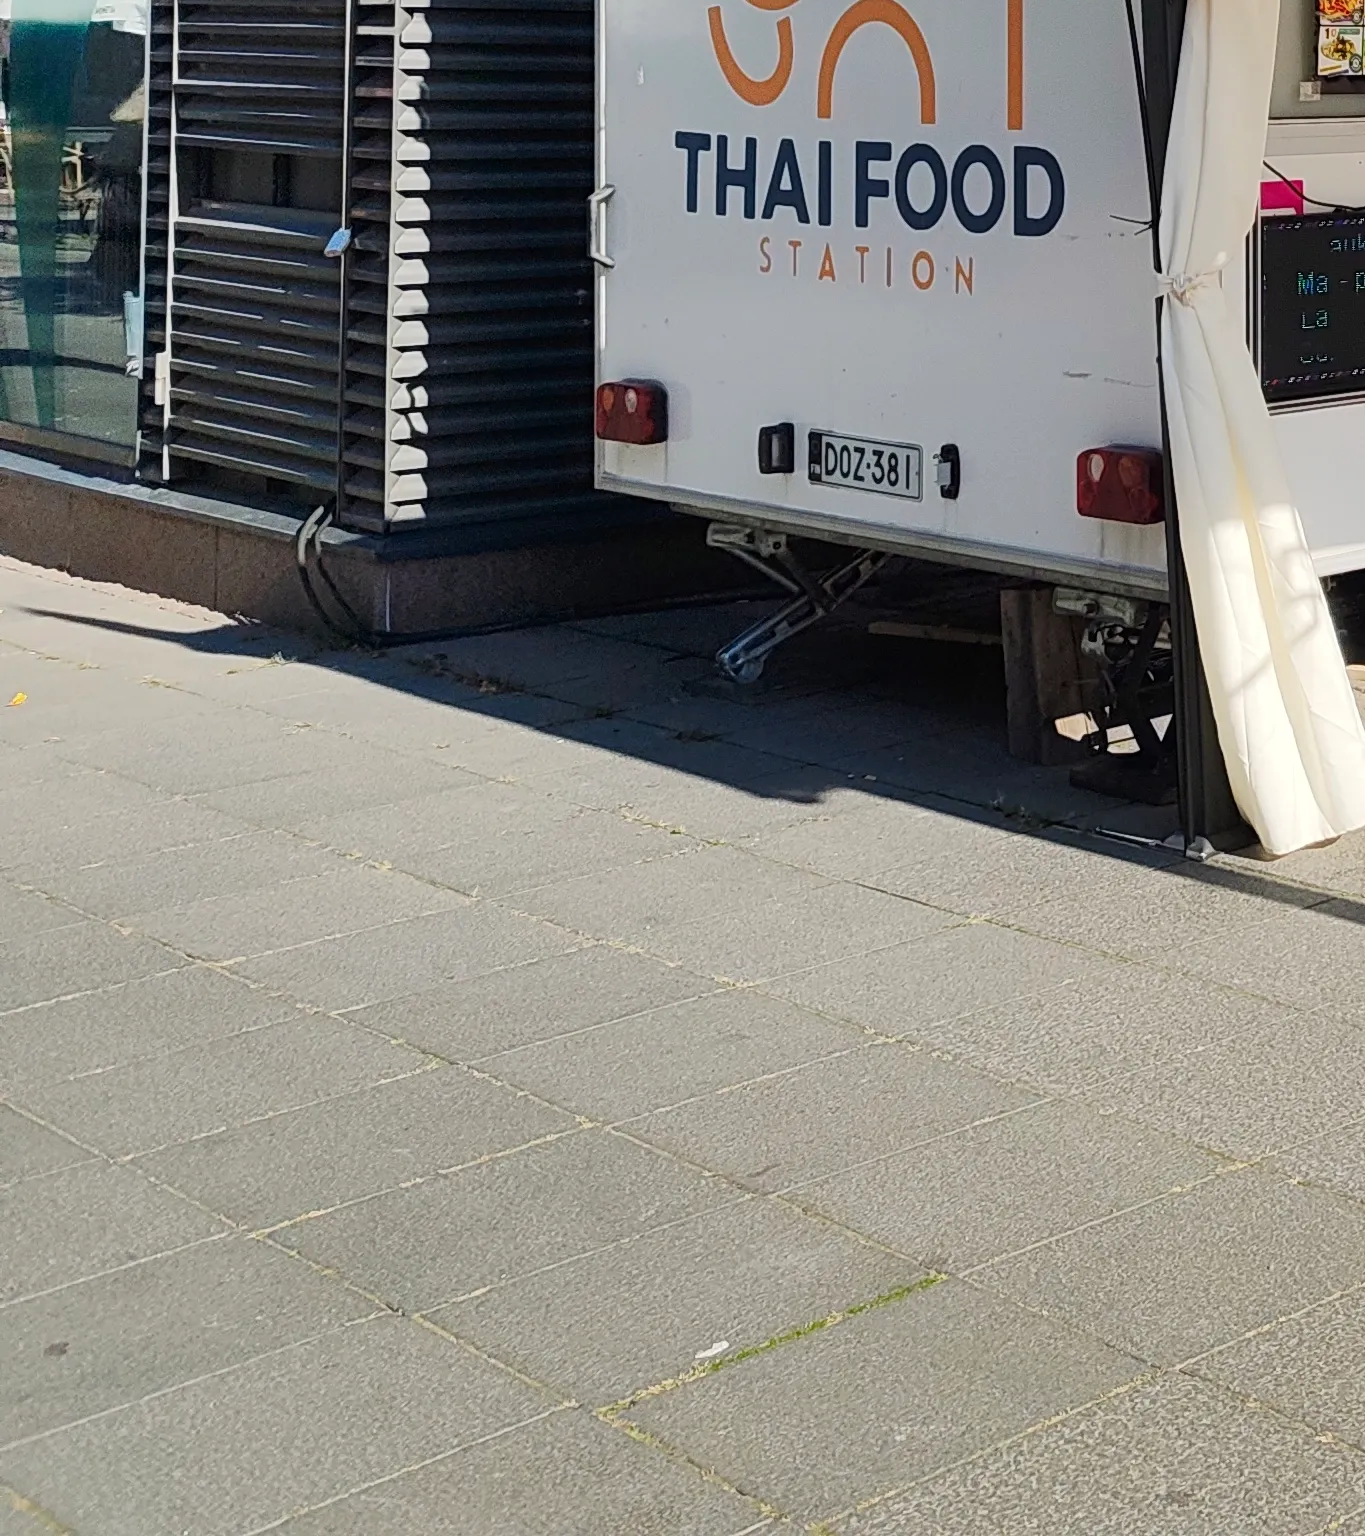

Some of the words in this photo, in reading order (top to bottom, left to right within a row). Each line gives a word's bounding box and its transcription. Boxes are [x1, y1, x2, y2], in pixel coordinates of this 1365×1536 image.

[675, 131, 833, 228] THAI
[855, 141, 1065, 237] FOOD
[760, 237, 975, 296] STATION
[825, 442, 910, 490] DOZ-381
